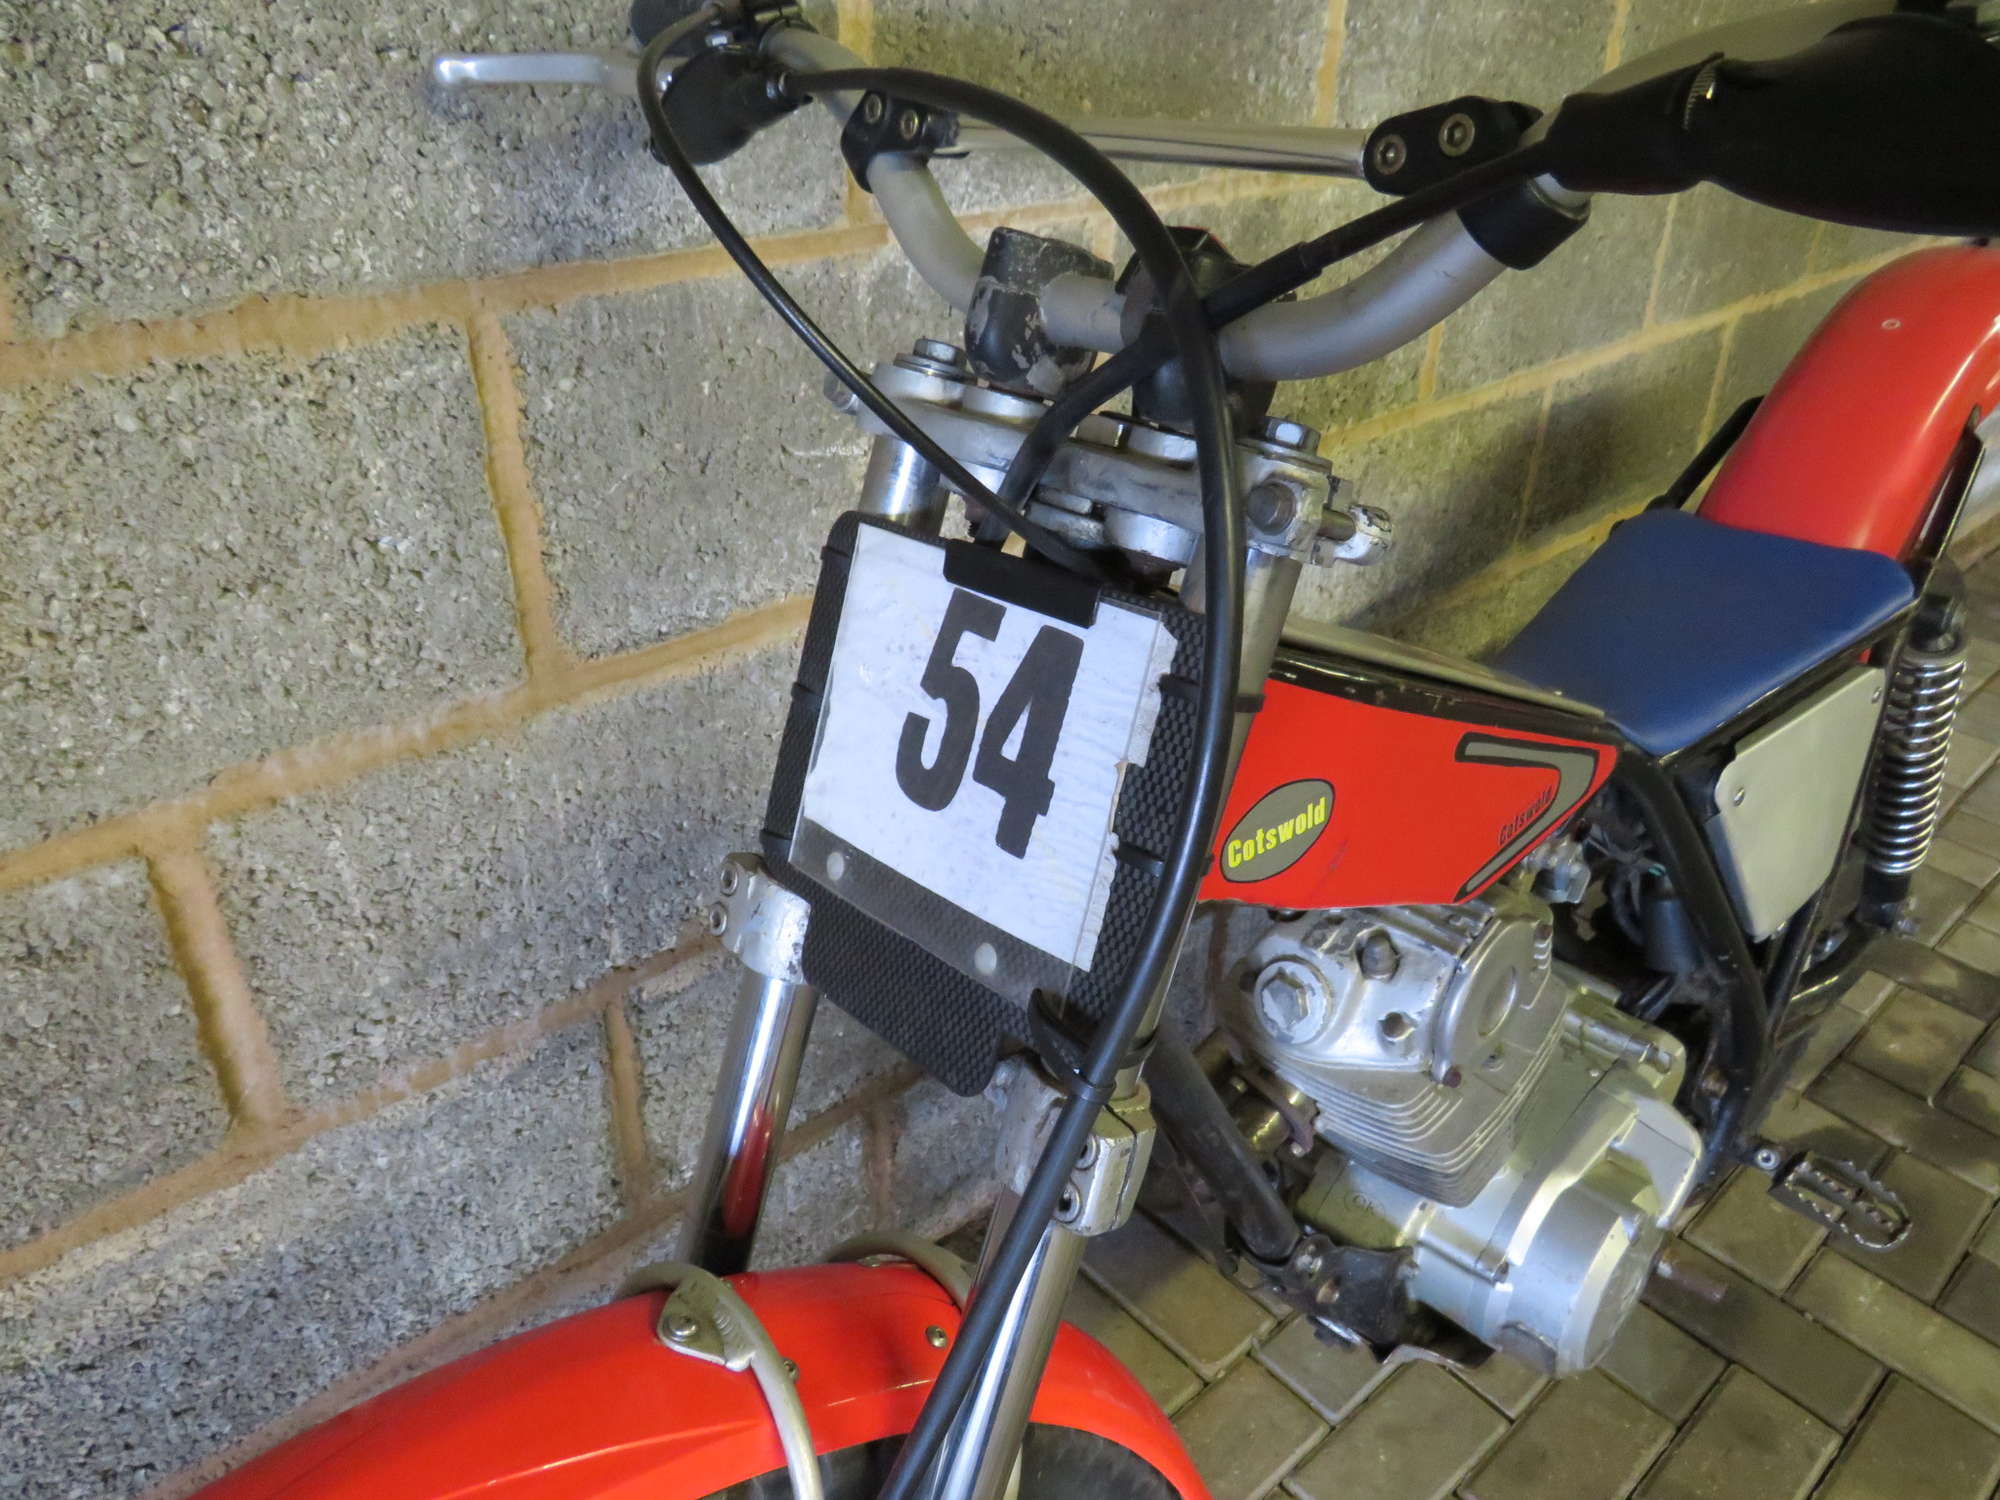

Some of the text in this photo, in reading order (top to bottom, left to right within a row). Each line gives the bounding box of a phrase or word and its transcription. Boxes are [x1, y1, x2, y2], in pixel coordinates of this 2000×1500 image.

[896, 587, 1084, 859] 54
[1228, 796, 1326, 868] Cotswold
[1499, 784, 1552, 846] Cotswold
